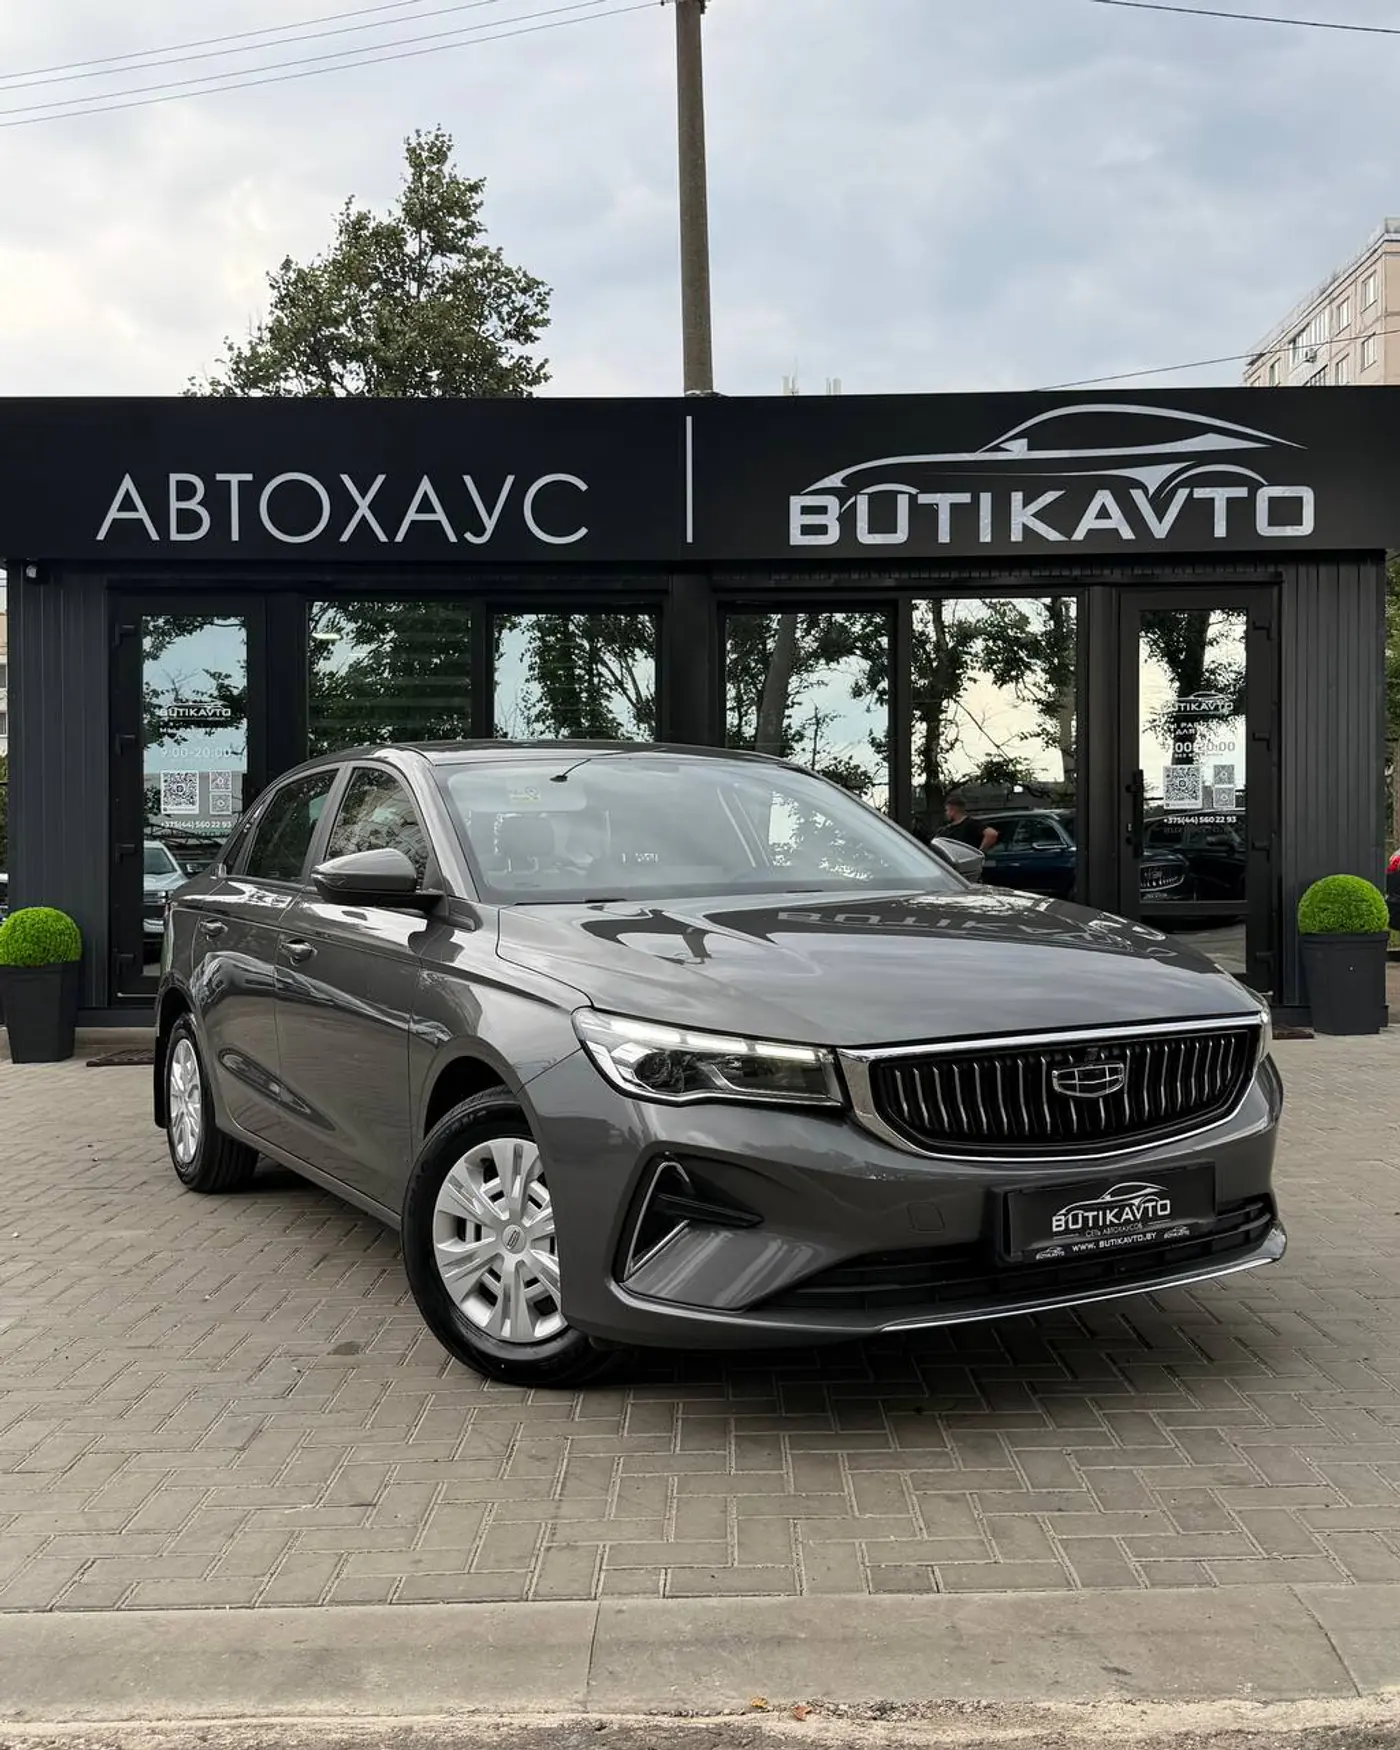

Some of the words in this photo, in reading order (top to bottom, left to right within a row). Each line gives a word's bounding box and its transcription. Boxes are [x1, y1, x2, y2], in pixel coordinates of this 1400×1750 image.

[95, 472, 590, 544] АВТОХАУС
[789, 484, 1316, 546] BUTIKAVTO
[159, 707, 231, 717] BUTIKAVTO
[1199, 815, 1214, 824] 560
[1215, 815, 1225, 824] 22
[1226, 815, 1237, 824] 93
[1051, 1200, 1171, 1232] BUTIKAVTO
